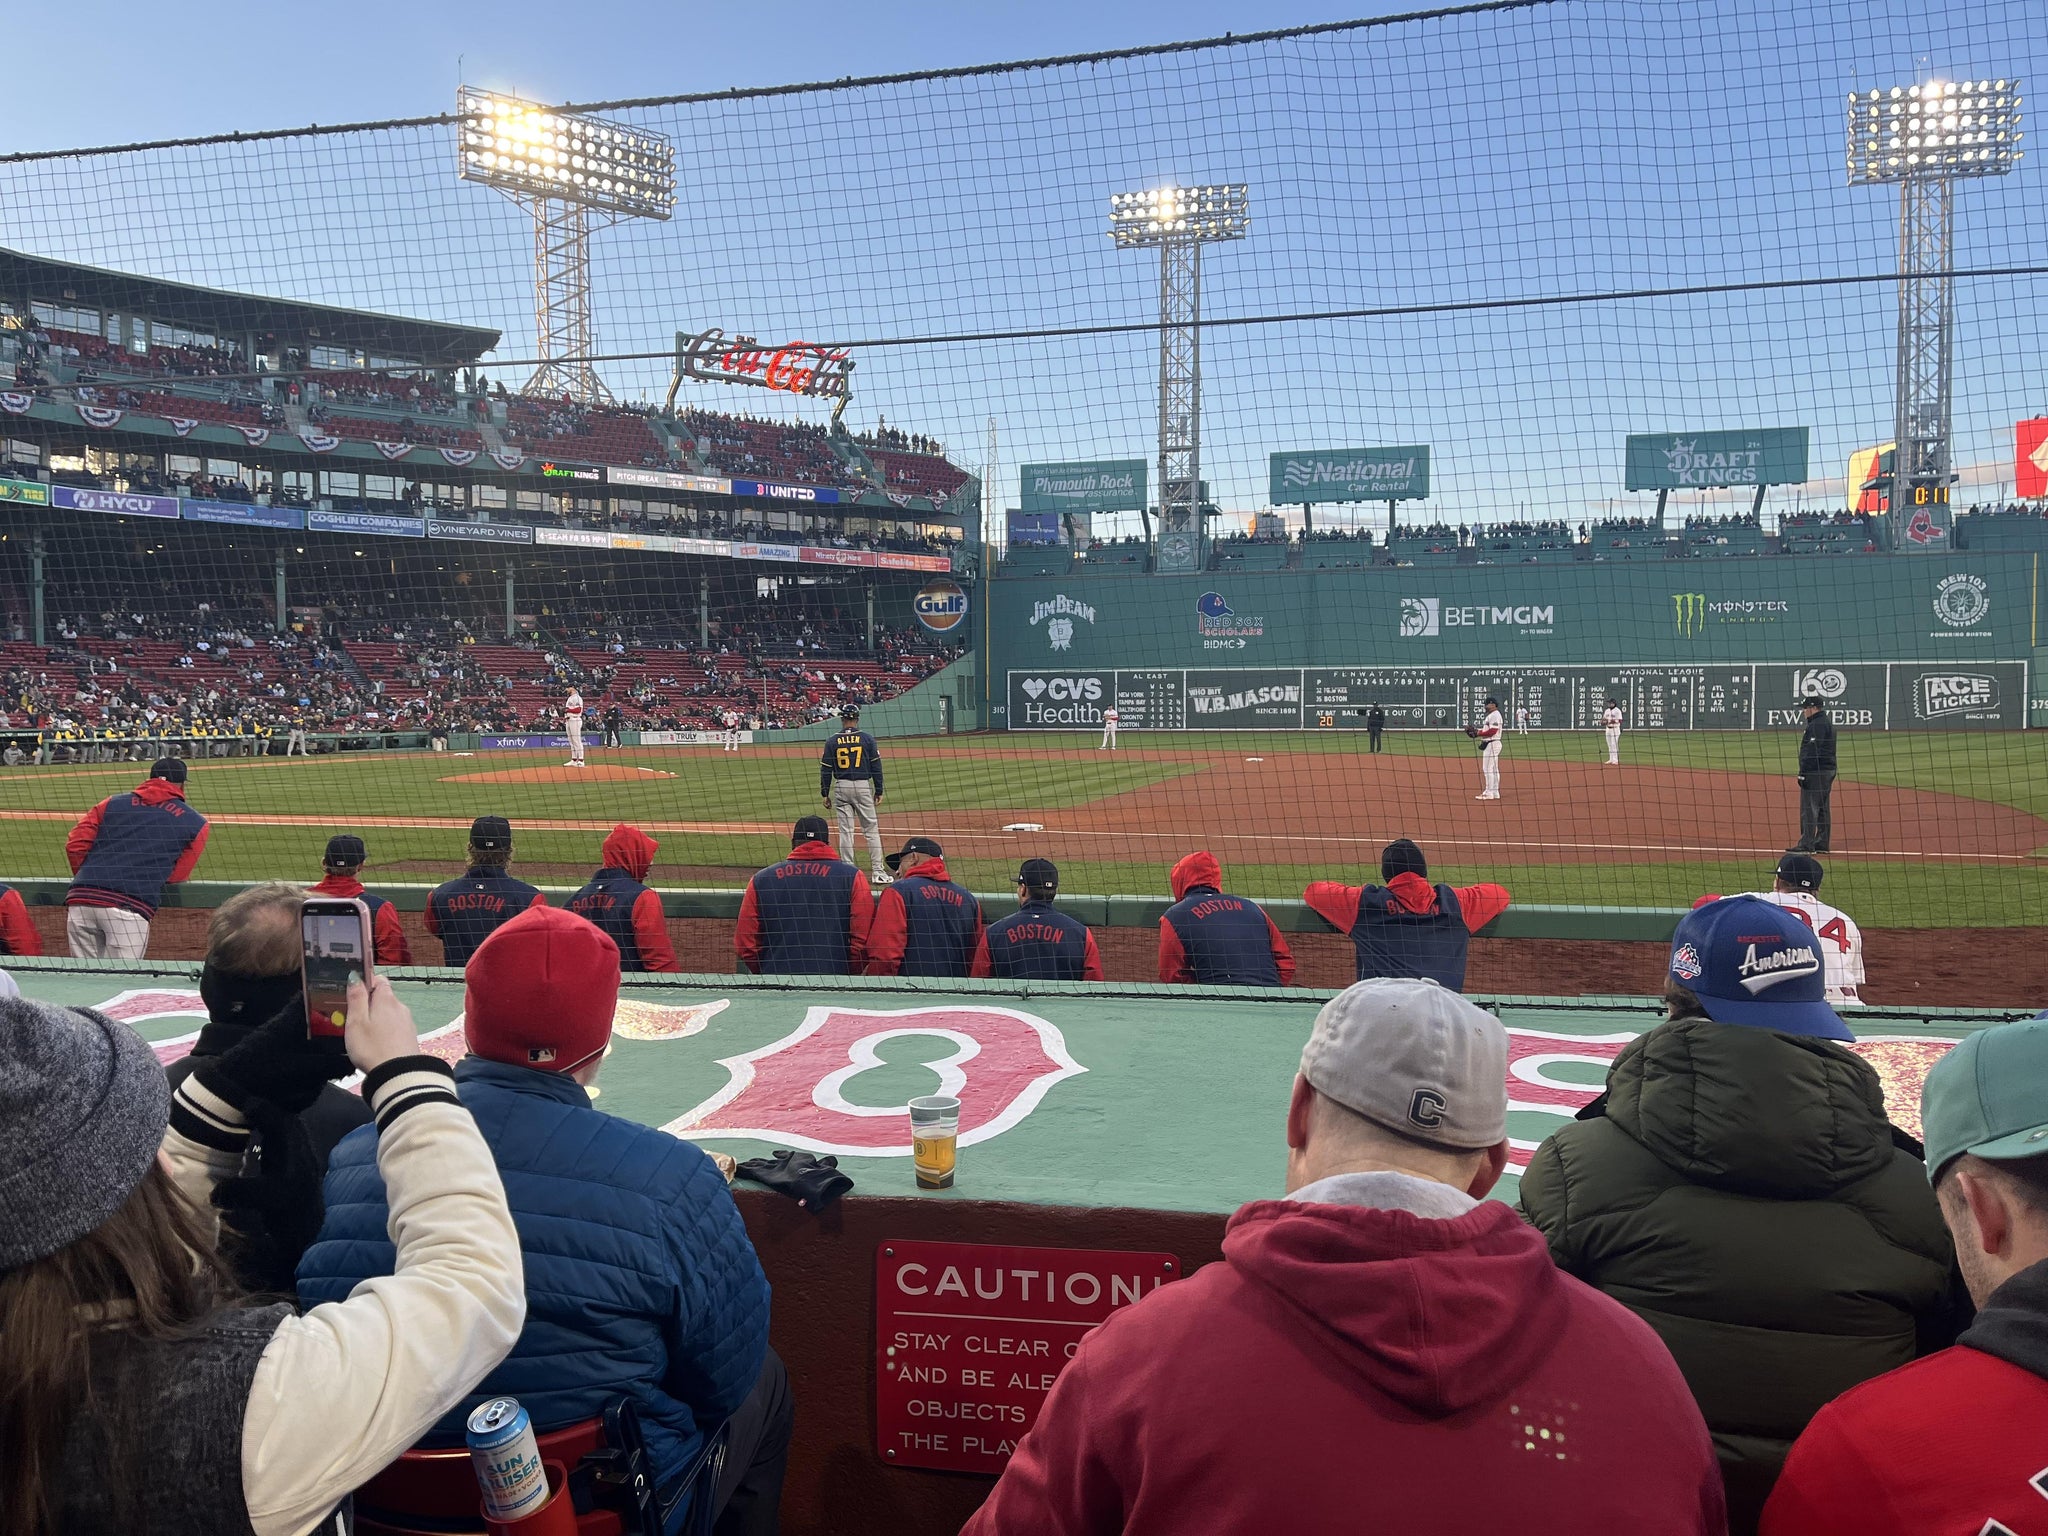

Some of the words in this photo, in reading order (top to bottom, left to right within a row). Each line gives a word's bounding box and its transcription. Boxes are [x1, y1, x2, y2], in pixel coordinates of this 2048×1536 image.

[1672, 449, 1760, 470] DRAFT
[616, 472, 636, 482] PITCH
[637, 474, 659, 484] BREAK
[1313, 457, 1415, 483] National
[1679, 466, 1757, 485] KINGS
[1034, 475, 1096, 493] Plymouth
[1099, 473, 1133, 489] Rock
[1348, 483, 1366, 492] Car
[1371, 480, 1410, 492] Rental
[23, 489, 45, 501] TIRE
[770, 486, 816, 500] UNITED
[1088, 488, 1134, 498] assurance
[1915, 487, 1949, 505] 0:11
[100, 495, 152, 512] HYCU
[311, 514, 359, 526] COGHLIN
[360, 517, 423, 529] COMPANIES
[441, 525, 495, 537] VINEYARD
[499, 529, 529, 539] VINES
[539, 533, 568, 542] 4-SEAM
[580, 535, 591, 543] 95
[758, 549, 791, 558] AMAZING
[815, 552, 836, 562] Ninety
[880, 557, 915, 568] Safelite
[1936, 573, 1968, 591] IBEW
[1968, 575, 1987, 591] 103
[916, 595, 965, 613] Gulf
[1030, 600, 1056, 626] JIM
[1055, 594, 1097, 625] BEAM
[1709, 600, 1789, 614] MONSTER
[1205, 617, 1231, 628] RED
[1235, 617, 1263, 627] SOX
[1446, 605, 1554, 626] BETMGM
[1204, 627, 1264, 637] SCHOLARS
[1204, 638, 1235, 649] BIDMC
[1048, 678, 1102, 700] CVS
[1188, 687, 1206, 696] WHO
[1207, 687, 1222, 695] BUT
[1793, 669, 1848, 698] 160
[1931, 677, 1990, 698] ACE
[1931, 693, 1991, 710] TICKET
[992, 706, 1005, 715] 310
[1025, 702, 1101, 724] Health
[1319, 716, 1333, 726] 20
[497, 737, 526, 748] xfinity
[677, 733, 697, 742] TRULY
[837, 736, 860, 744] ALLEN
[836, 746, 862, 769] 67
[775, 863, 831, 880] BOSTON
[447, 893, 506, 913] BOSTON
[919, 884, 964, 908] BOSTON
[1190, 899, 1243, 921] BOSTON
[1006, 924, 1064, 945] BOSTON
[1408, 1088, 1447, 1130] C
[894, 1333, 951, 1351] STAY
[965, 1336, 1050, 1357] CLEAR
[898, 1366, 948, 1384] AND
[962, 1369, 995, 1387] BE
[907, 1400, 1026, 1423] OBJECTS
[899, 1432, 949, 1451] THE
[487, 1452, 524, 1476] SUN
